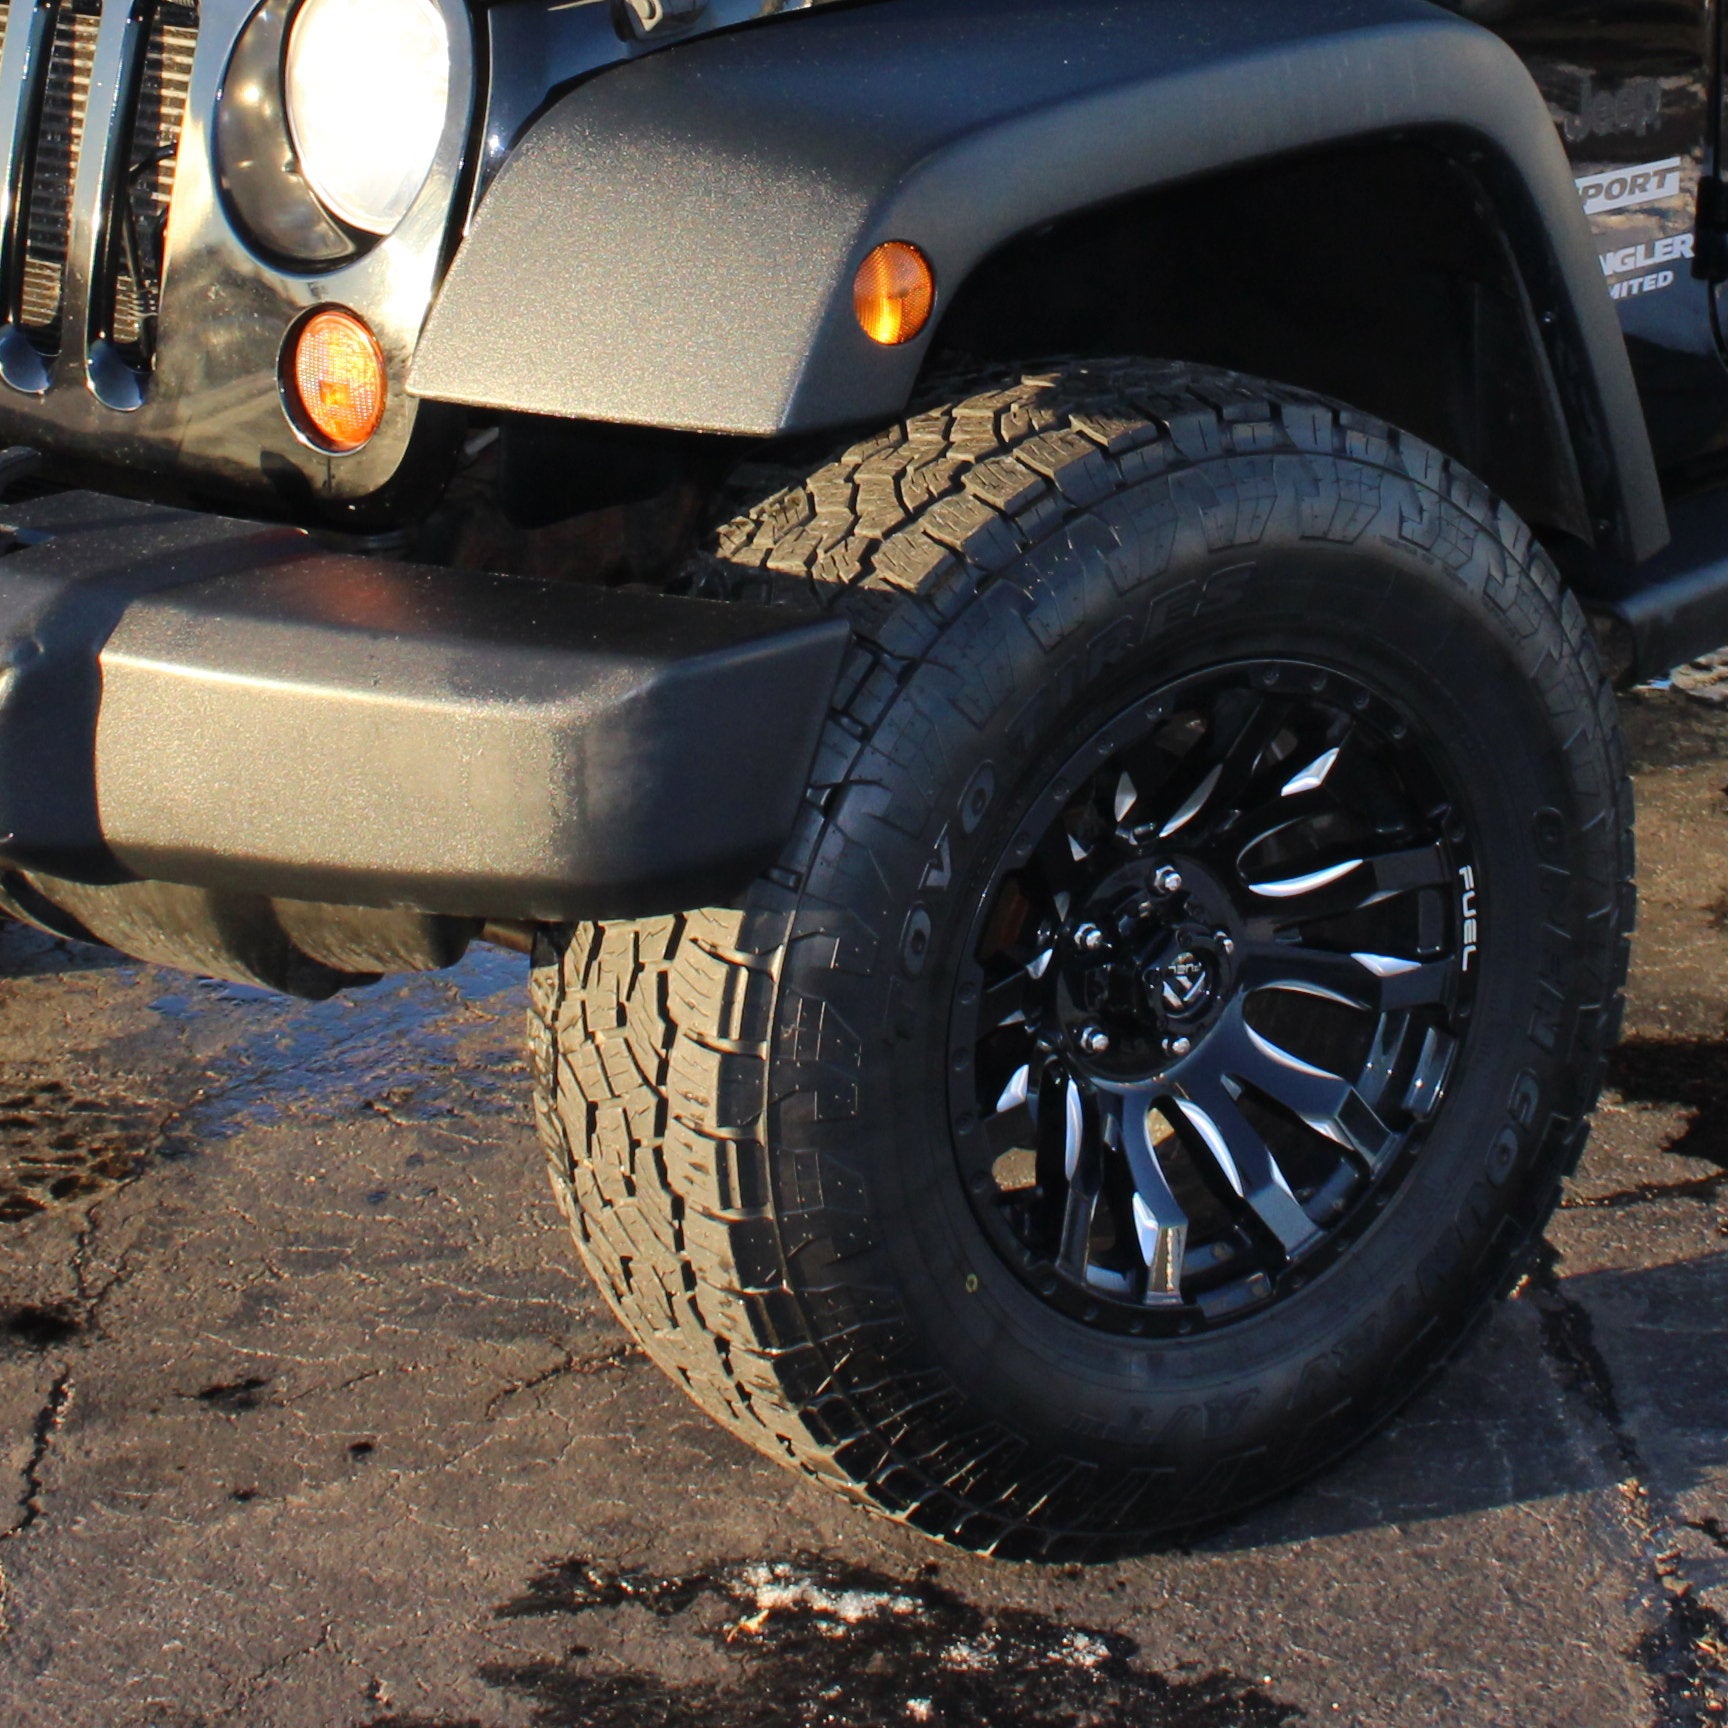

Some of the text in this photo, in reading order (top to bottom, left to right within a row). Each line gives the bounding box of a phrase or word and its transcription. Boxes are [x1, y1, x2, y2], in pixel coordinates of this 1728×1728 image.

[1563, 75, 1661, 143] Jeep
[1578, 161, 1680, 203] PORT
[1598, 232, 1695, 276] NGLER
[1456, 863, 1478, 973] FUEL
